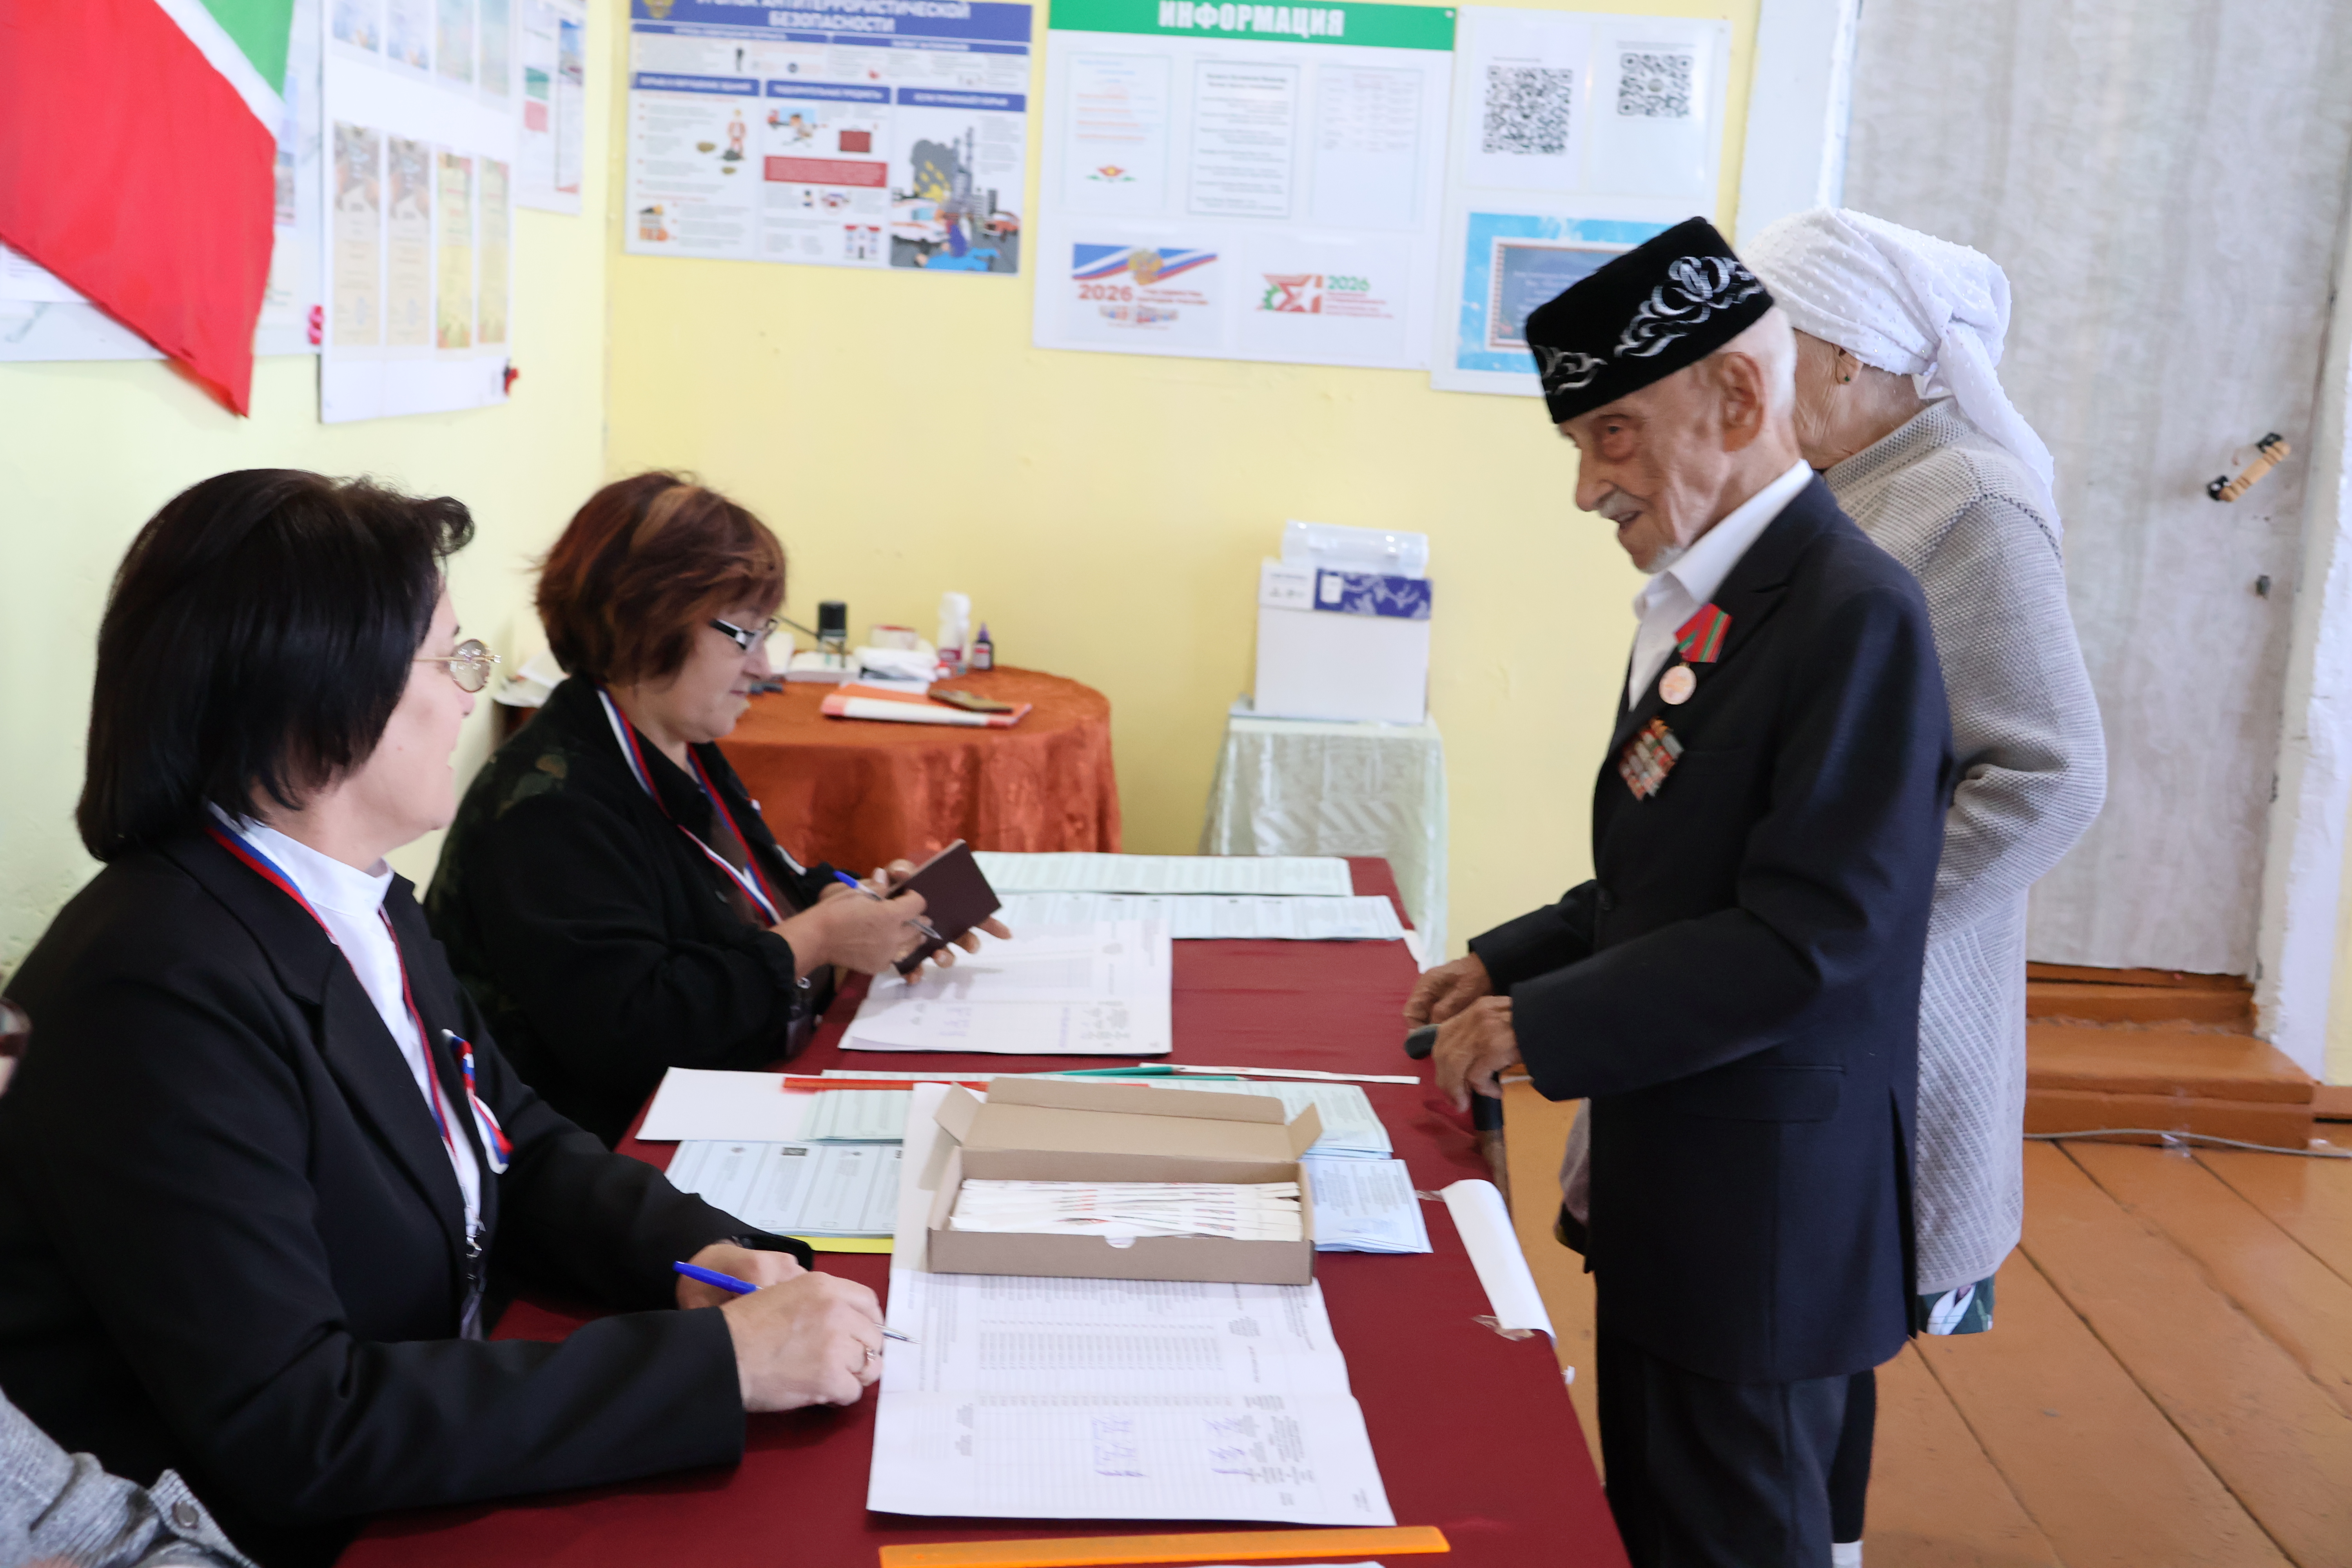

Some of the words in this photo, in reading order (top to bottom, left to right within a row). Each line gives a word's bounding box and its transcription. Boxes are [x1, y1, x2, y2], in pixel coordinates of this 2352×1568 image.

[769, 10, 896, 33] БЕЗОПАСНОСТИ
[1158, 0, 1345, 38] ИНФОРМАЦИЯ
[1078, 284, 1134, 303] 2026
[1328, 275, 1370, 292] 2026
